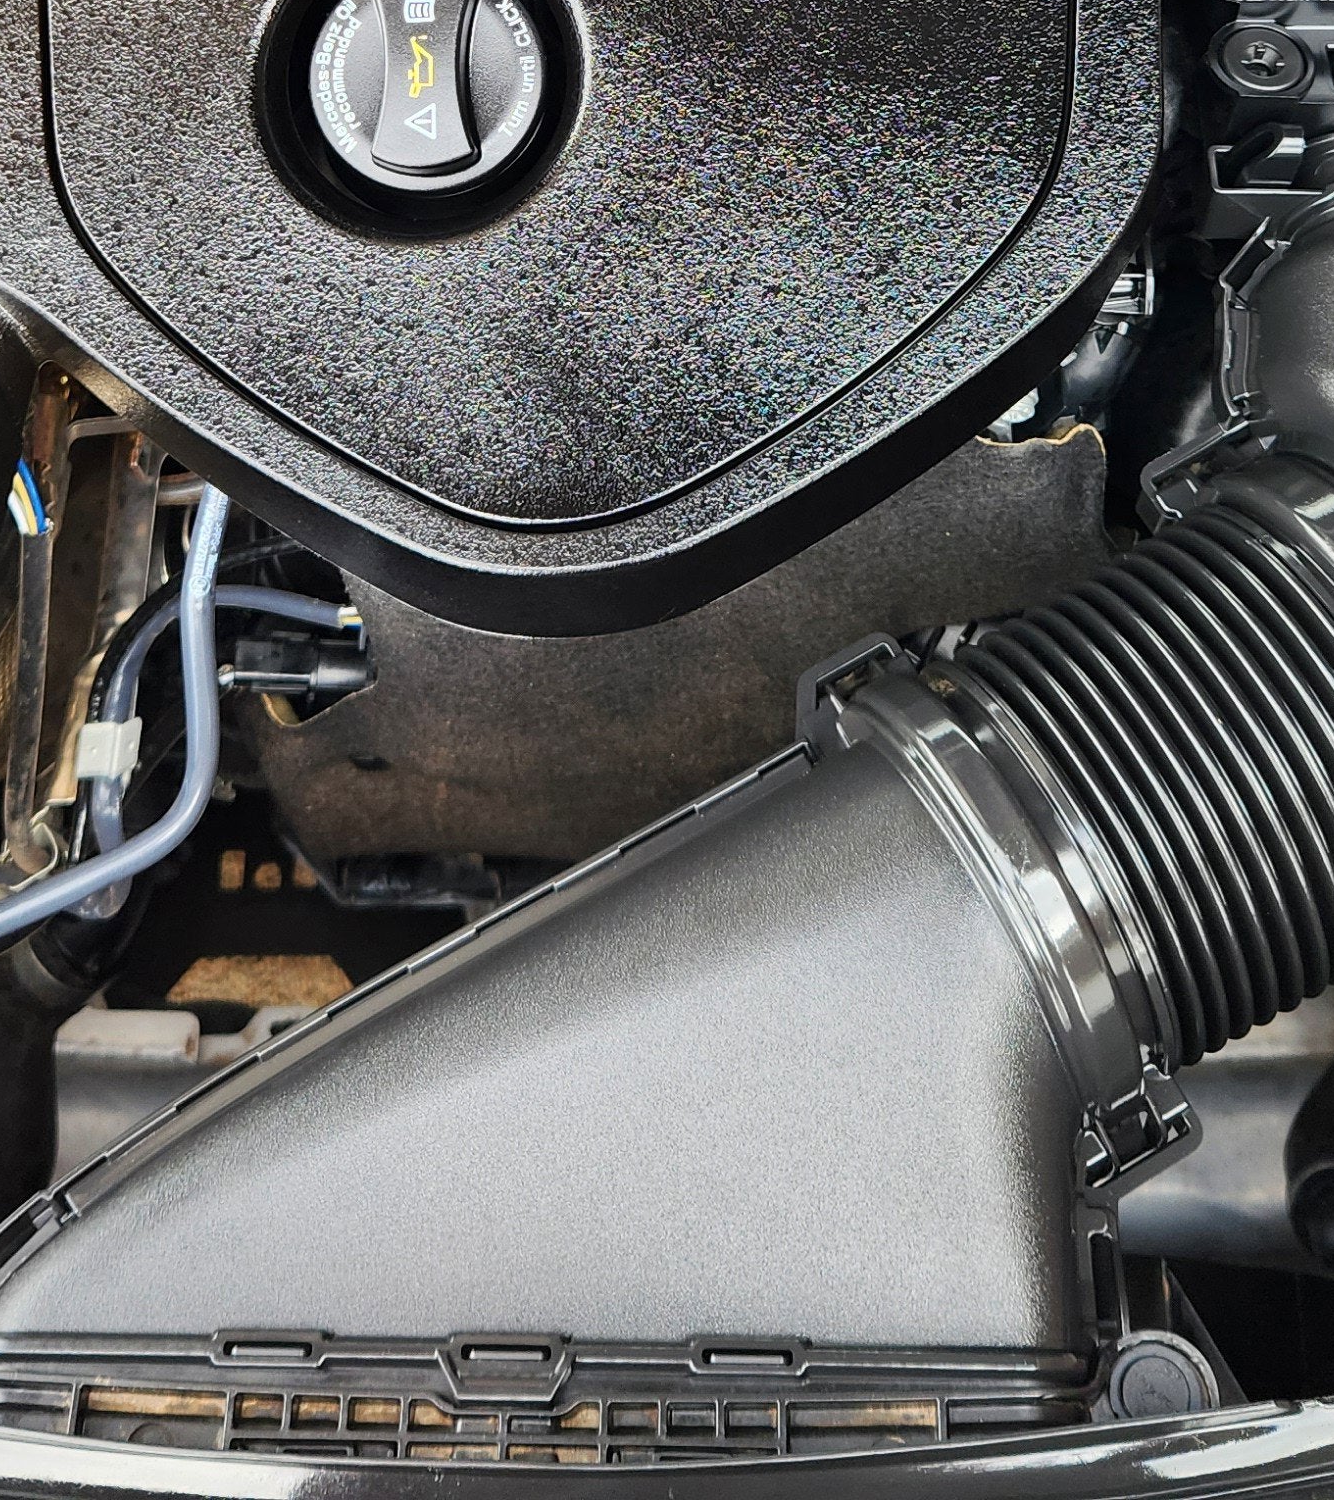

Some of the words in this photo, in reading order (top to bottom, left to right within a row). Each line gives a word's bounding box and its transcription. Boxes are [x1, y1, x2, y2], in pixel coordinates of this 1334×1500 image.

[315, 23, 358, 153] Mercedes-Benz
[331, 16, 363, 131] recommended
[497, 99, 529, 138] Turn
[520, 55, 536, 93] until
